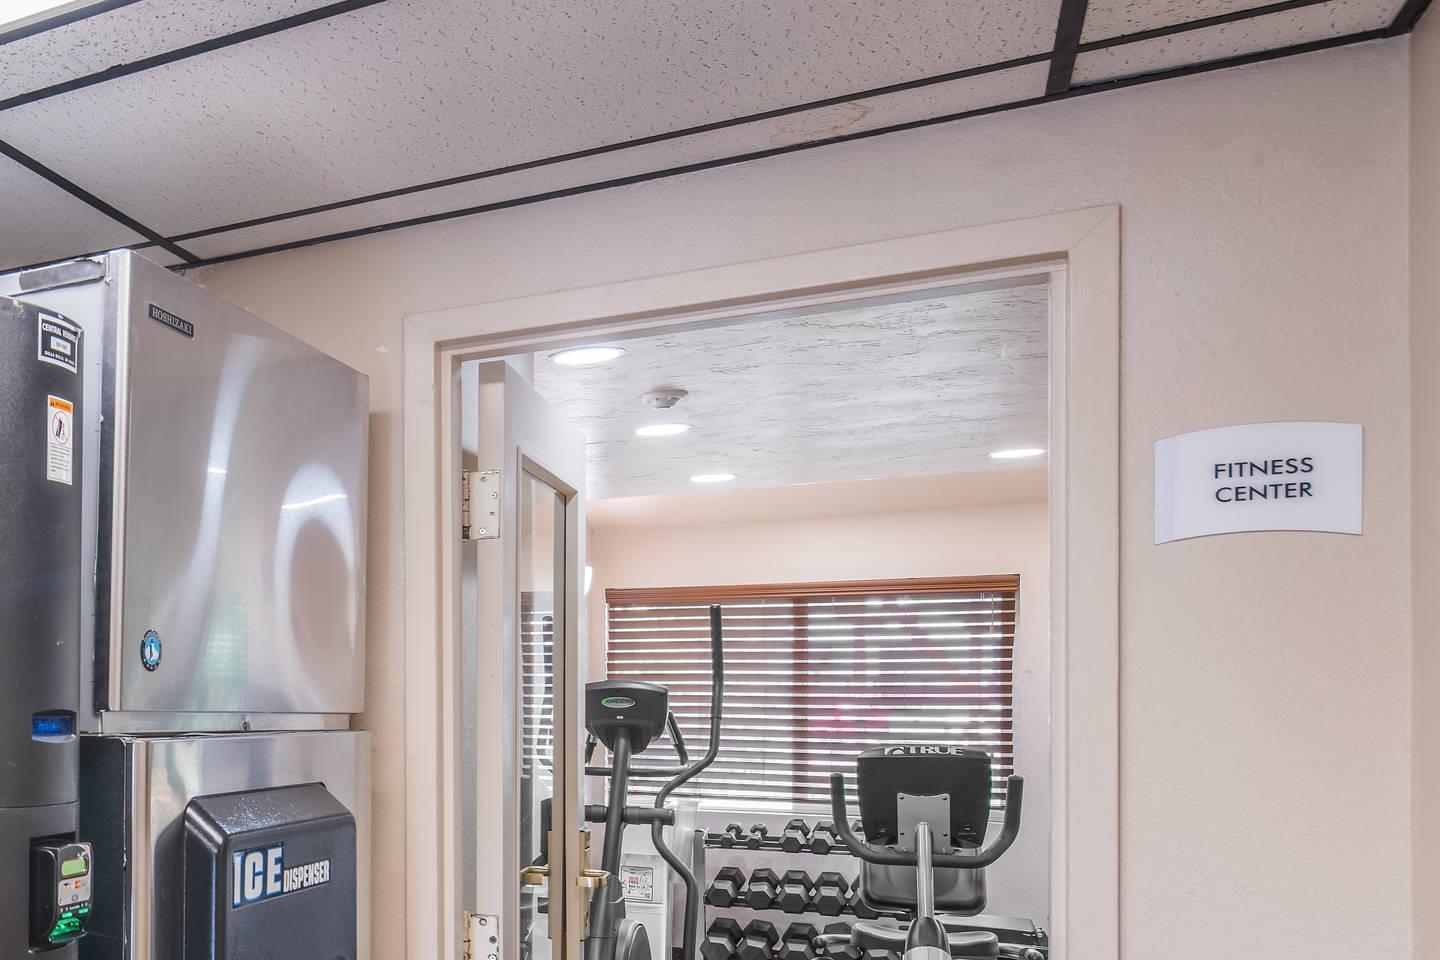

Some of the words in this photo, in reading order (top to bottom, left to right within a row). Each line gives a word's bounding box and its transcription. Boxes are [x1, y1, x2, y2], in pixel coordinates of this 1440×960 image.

[151, 307, 193, 335] HOSHIZAKI
[1214, 457, 1314, 479] FITNESS
[1215, 482, 1313, 503] CENTER
[909, 745, 964, 756] TRUE
[232, 843, 284, 906] ICE
[283, 859, 330, 893] DISPENSER
